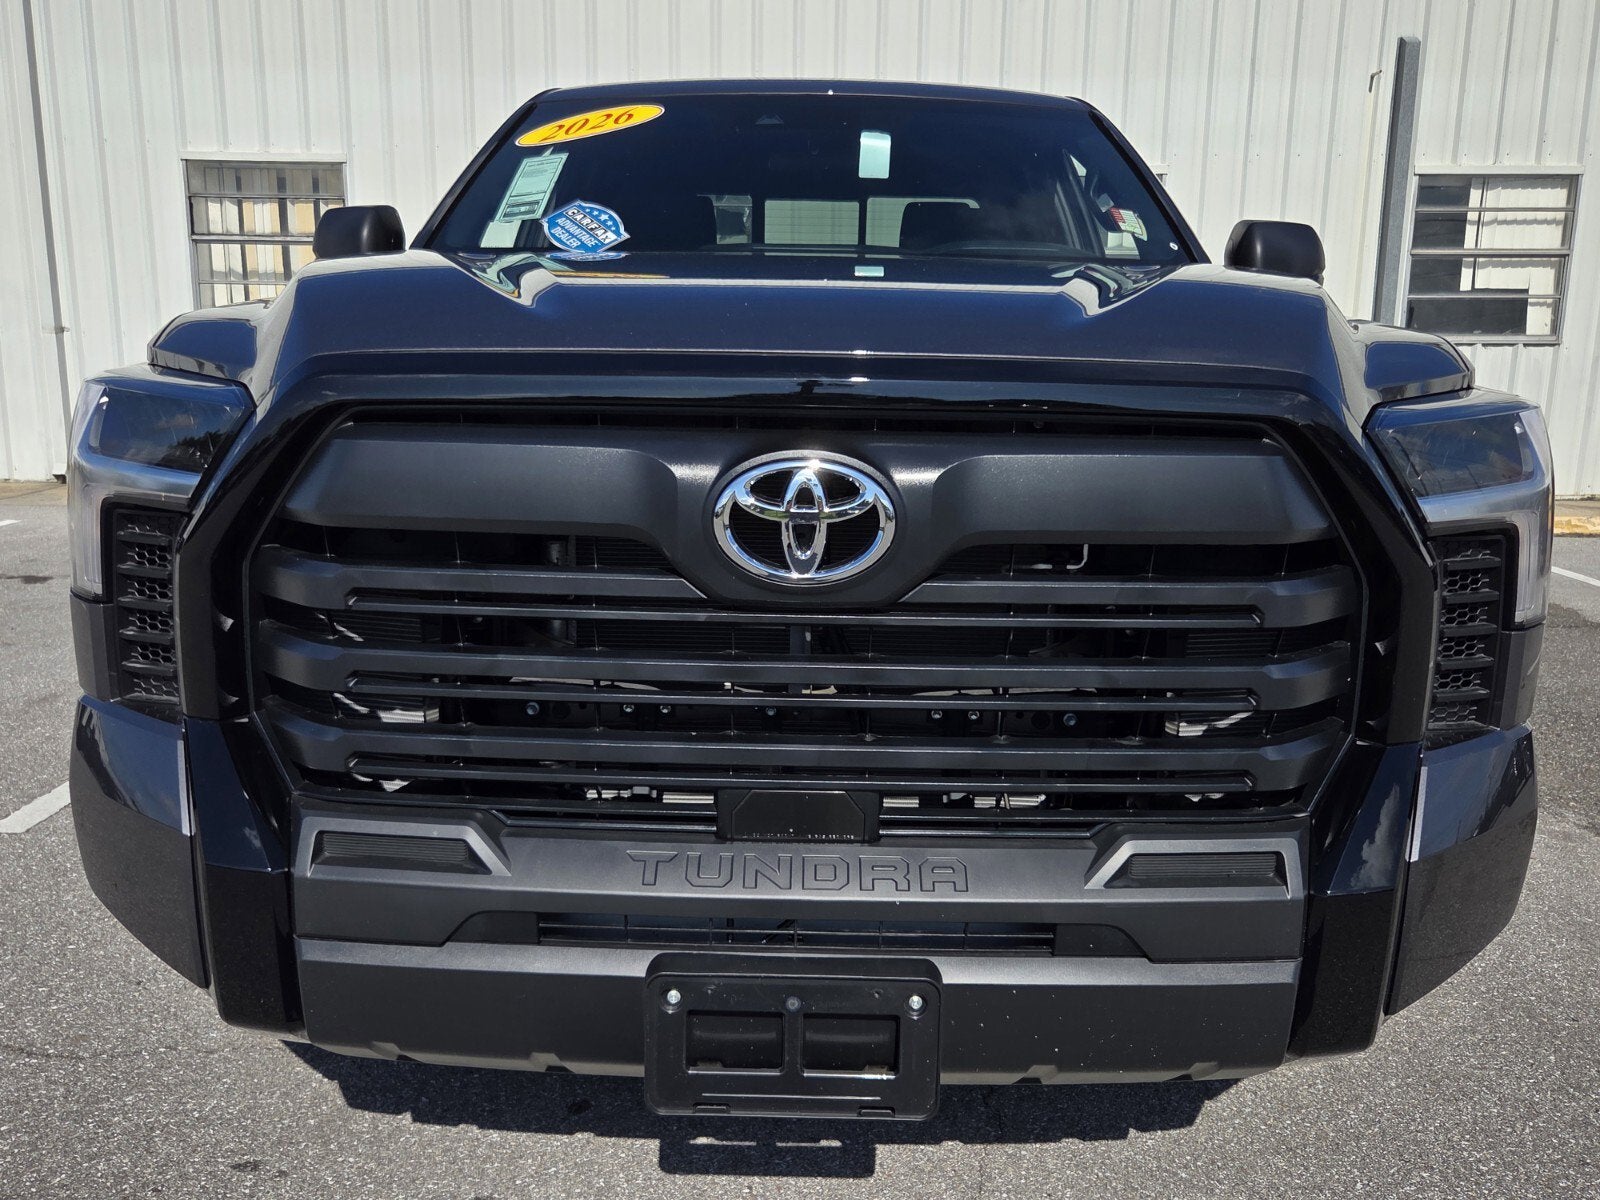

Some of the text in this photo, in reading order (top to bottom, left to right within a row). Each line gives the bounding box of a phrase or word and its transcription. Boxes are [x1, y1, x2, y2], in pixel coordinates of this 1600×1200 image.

[539, 106, 640, 142] 2026
[551, 226, 581, 248] DEALER
[555, 217, 599, 247] ADVANTAGE
[564, 207, 616, 243] CARFAX
[626, 850, 969, 892] TUNDRA
